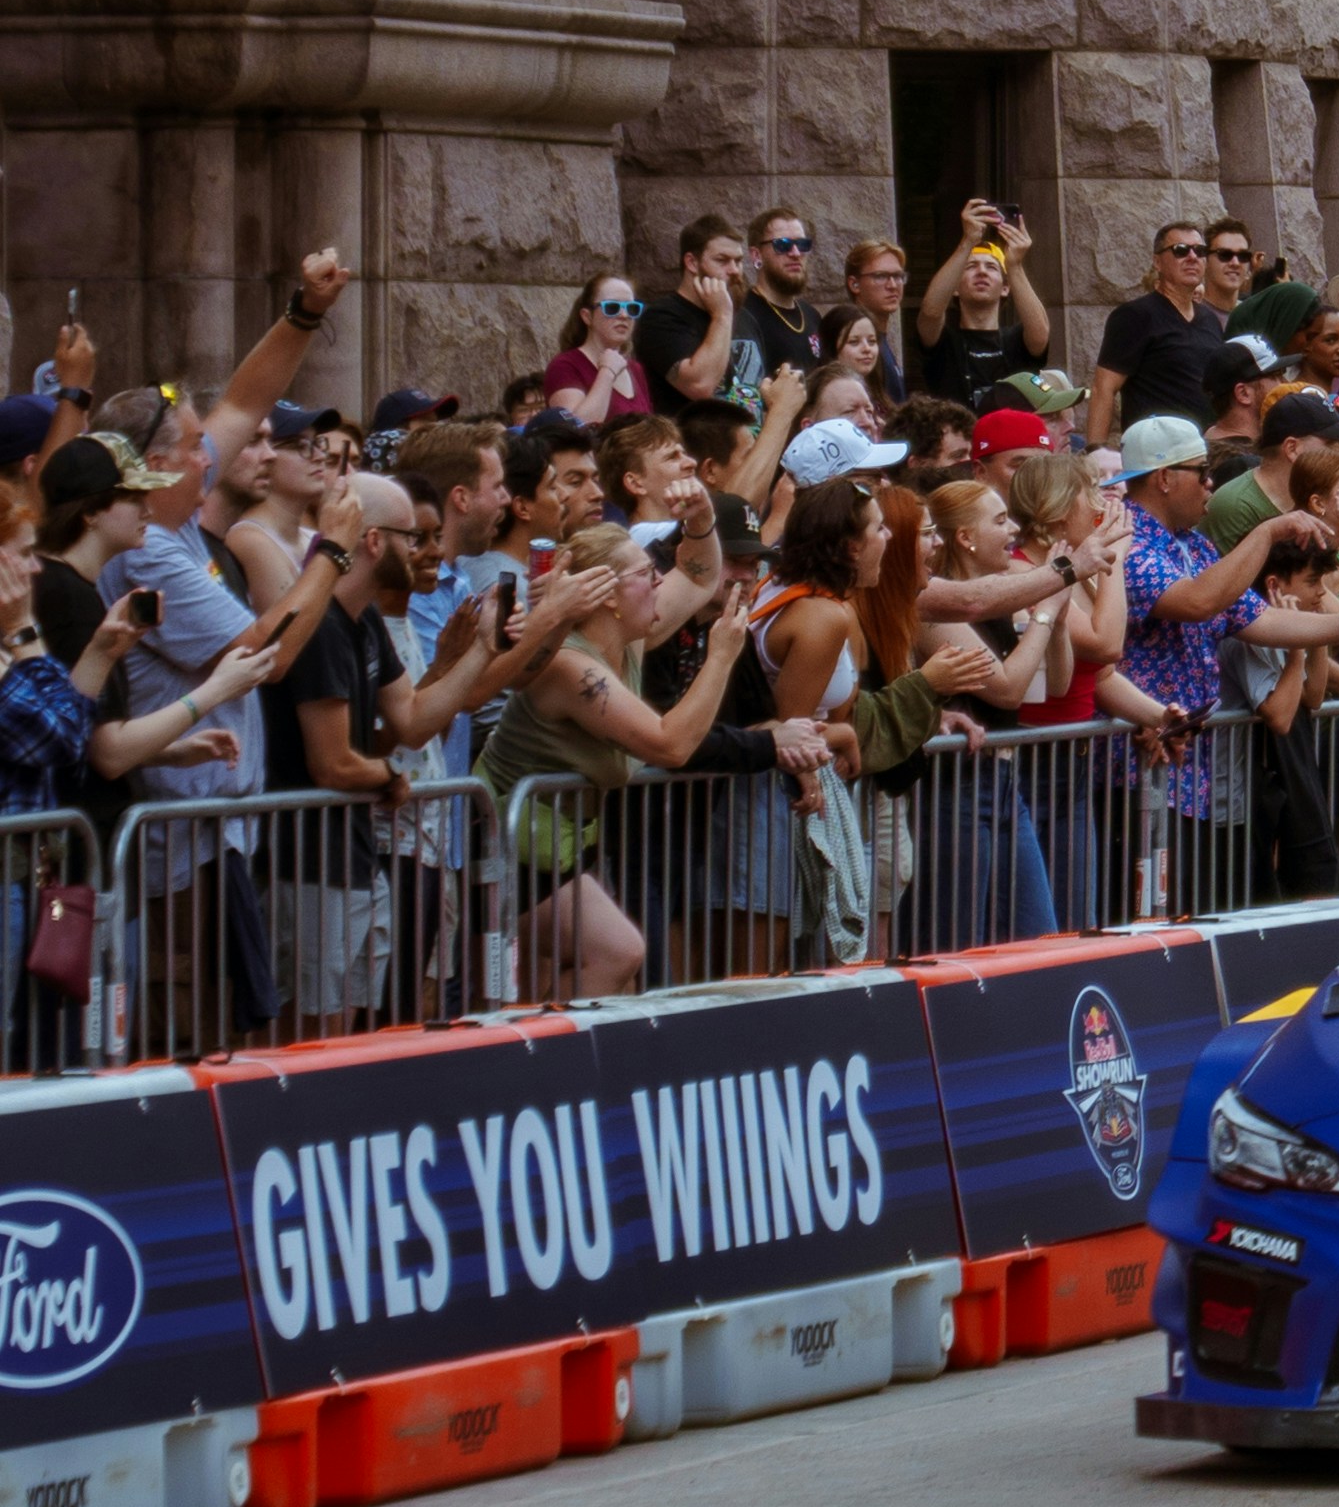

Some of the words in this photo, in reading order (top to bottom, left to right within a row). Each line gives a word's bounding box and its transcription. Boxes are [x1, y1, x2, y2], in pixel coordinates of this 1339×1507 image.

[818, 442, 841, 463] 10
[743, 505, 760, 533] LA
[1076, 1057, 1132, 1091] SHOWRUN
[252, 1124, 451, 1340] GIVES
[458, 1100, 611, 1298] YOU
[632, 1054, 883, 1263] WIIINGS
[1229, 1226, 1299, 1262] YOKOHAMA
[790, 1318, 838, 1356] YODOCK
[448, 1402, 502, 1444] YODOCK
